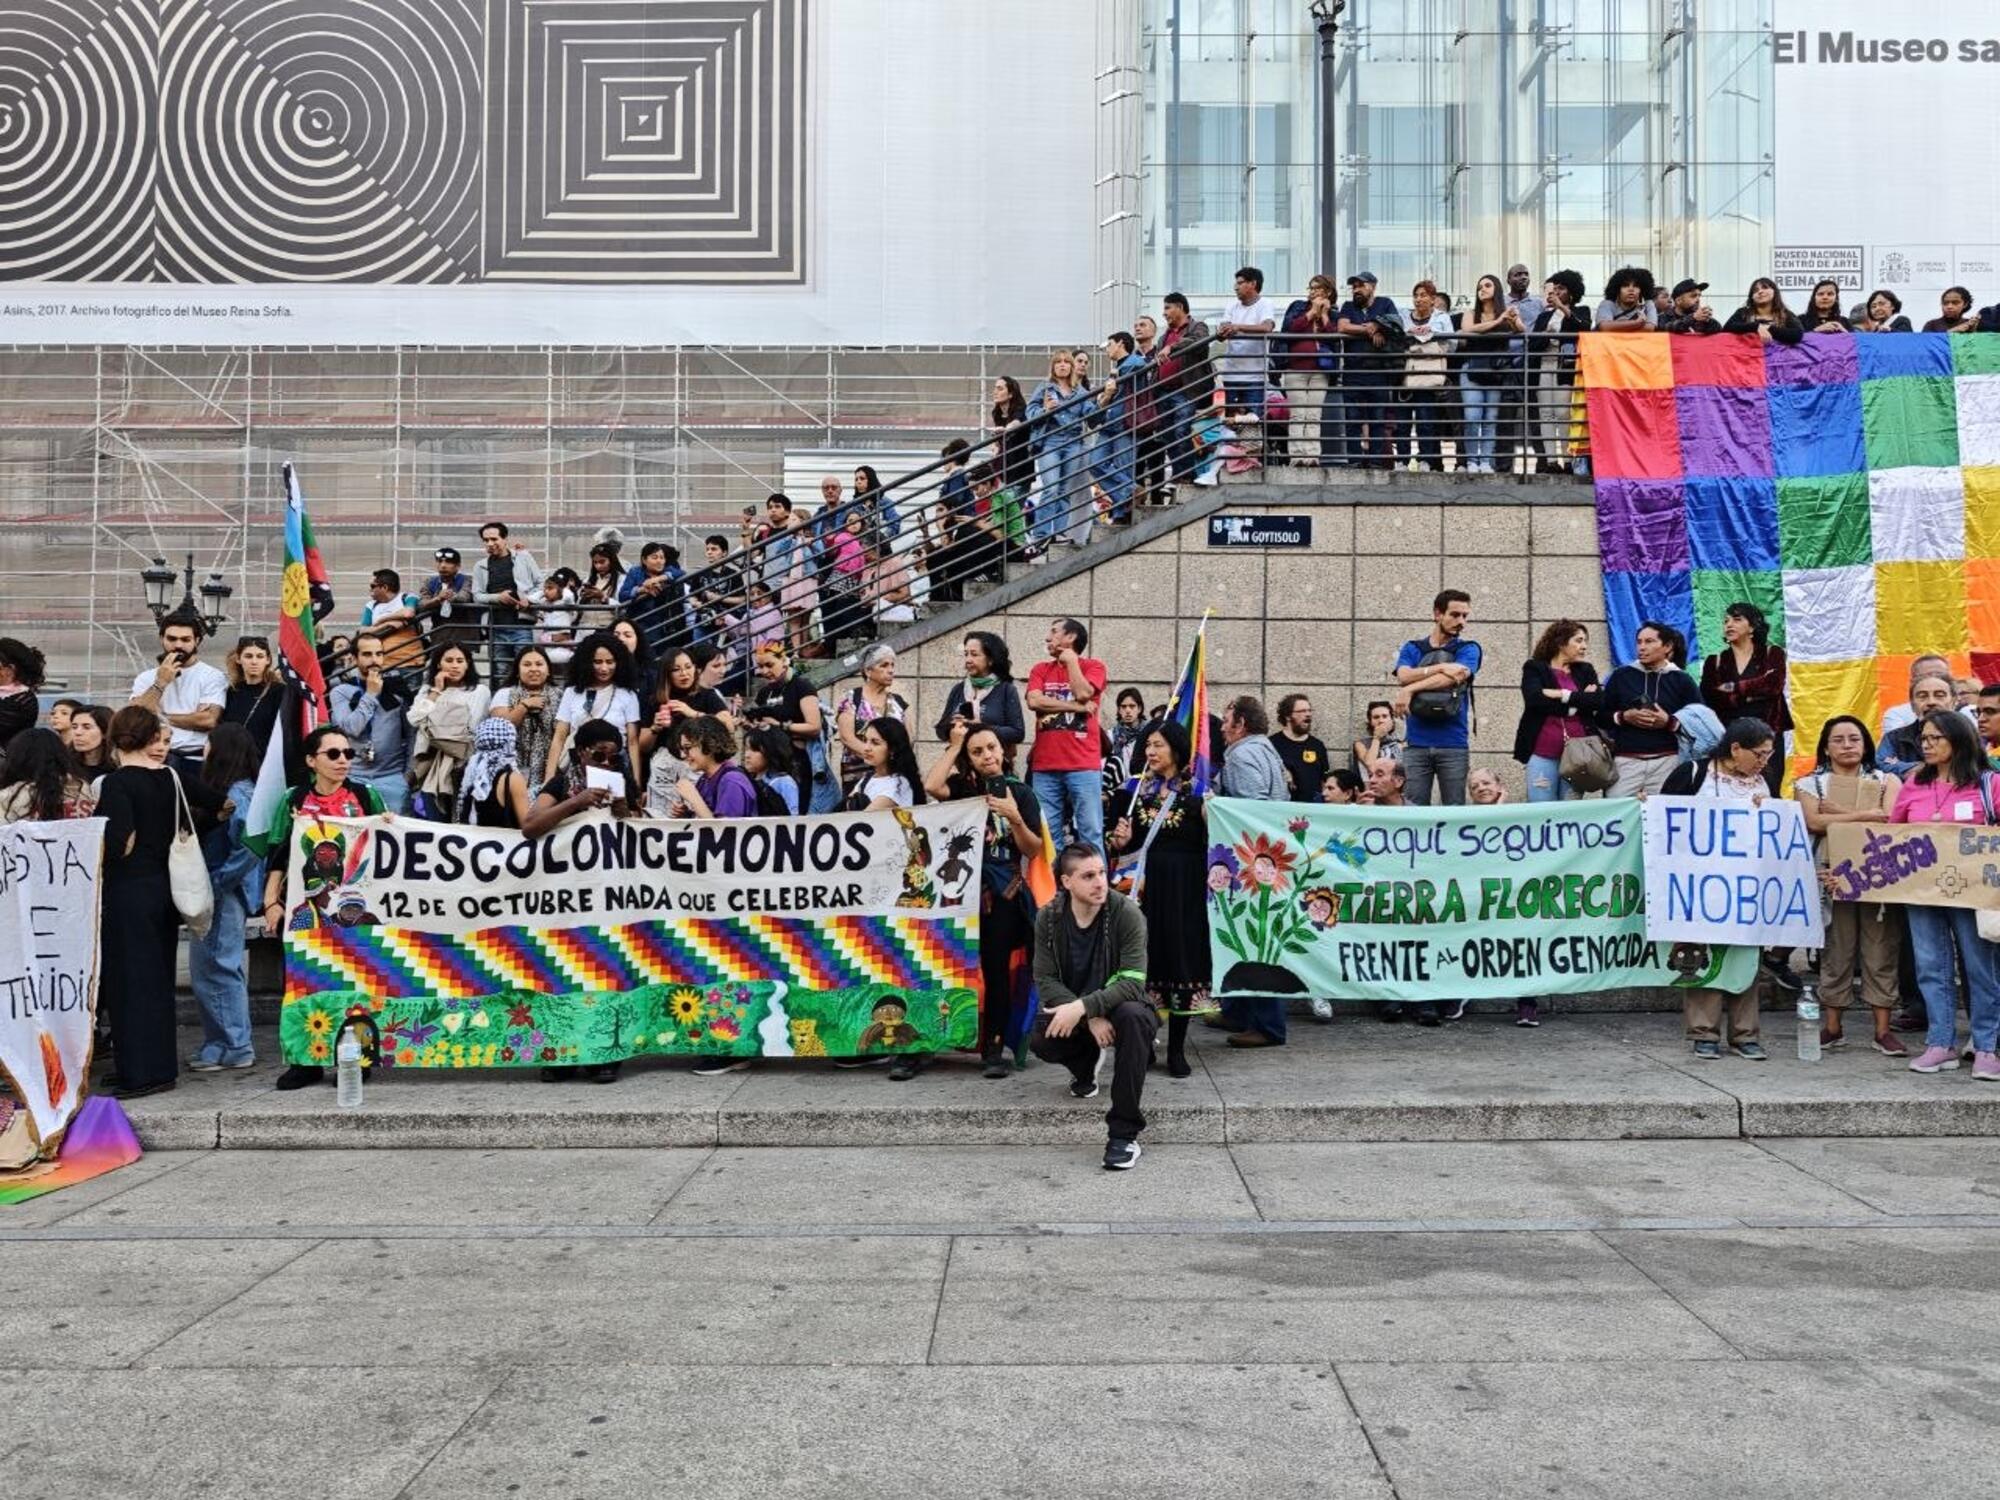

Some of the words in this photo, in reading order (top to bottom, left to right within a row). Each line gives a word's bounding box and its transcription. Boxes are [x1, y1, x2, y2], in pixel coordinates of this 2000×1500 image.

[1773, 31, 1806, 63] El
[1818, 31, 1949, 63] Museo
[1957, 39, 2000, 63] sa
[1774, 250, 1809, 259] MUSEO
[1810, 250, 1859, 259] NACIONAL
[1774, 260, 1815, 268] CENTRO
[1816, 260, 1831, 268] DE
[1832, 260, 1859, 268] ARTE
[1775, 275, 1816, 287] REINA
[70, 305, 111, 316] Archivo
[113, 305, 171, 318] fotográfico
[173, 305, 190, 316] del
[192, 305, 228, 316] Museo
[230, 305, 261, 316] Reina
[373, 822, 875, 882] DESCOLONICÉMONOS
[1665, 807, 1810, 862] FUERA
[0, 833, 92, 895] ASTA
[379, 891, 413, 918] 12
[418, 898, 446, 916] DE
[458, 888, 593, 919] OCTUBRE
[605, 884, 673, 911] NADA
[678, 892, 716, 912] QUE
[727, 884, 864, 912] CELEBRAR
[1668, 873, 1810, 927] NOBOA
[1338, 940, 1430, 983] FRENTE
[1436, 947, 1460, 970] AL
[1461, 937, 1542, 979] ORDEN
[1549, 932, 1660, 976] GENOCIDA
